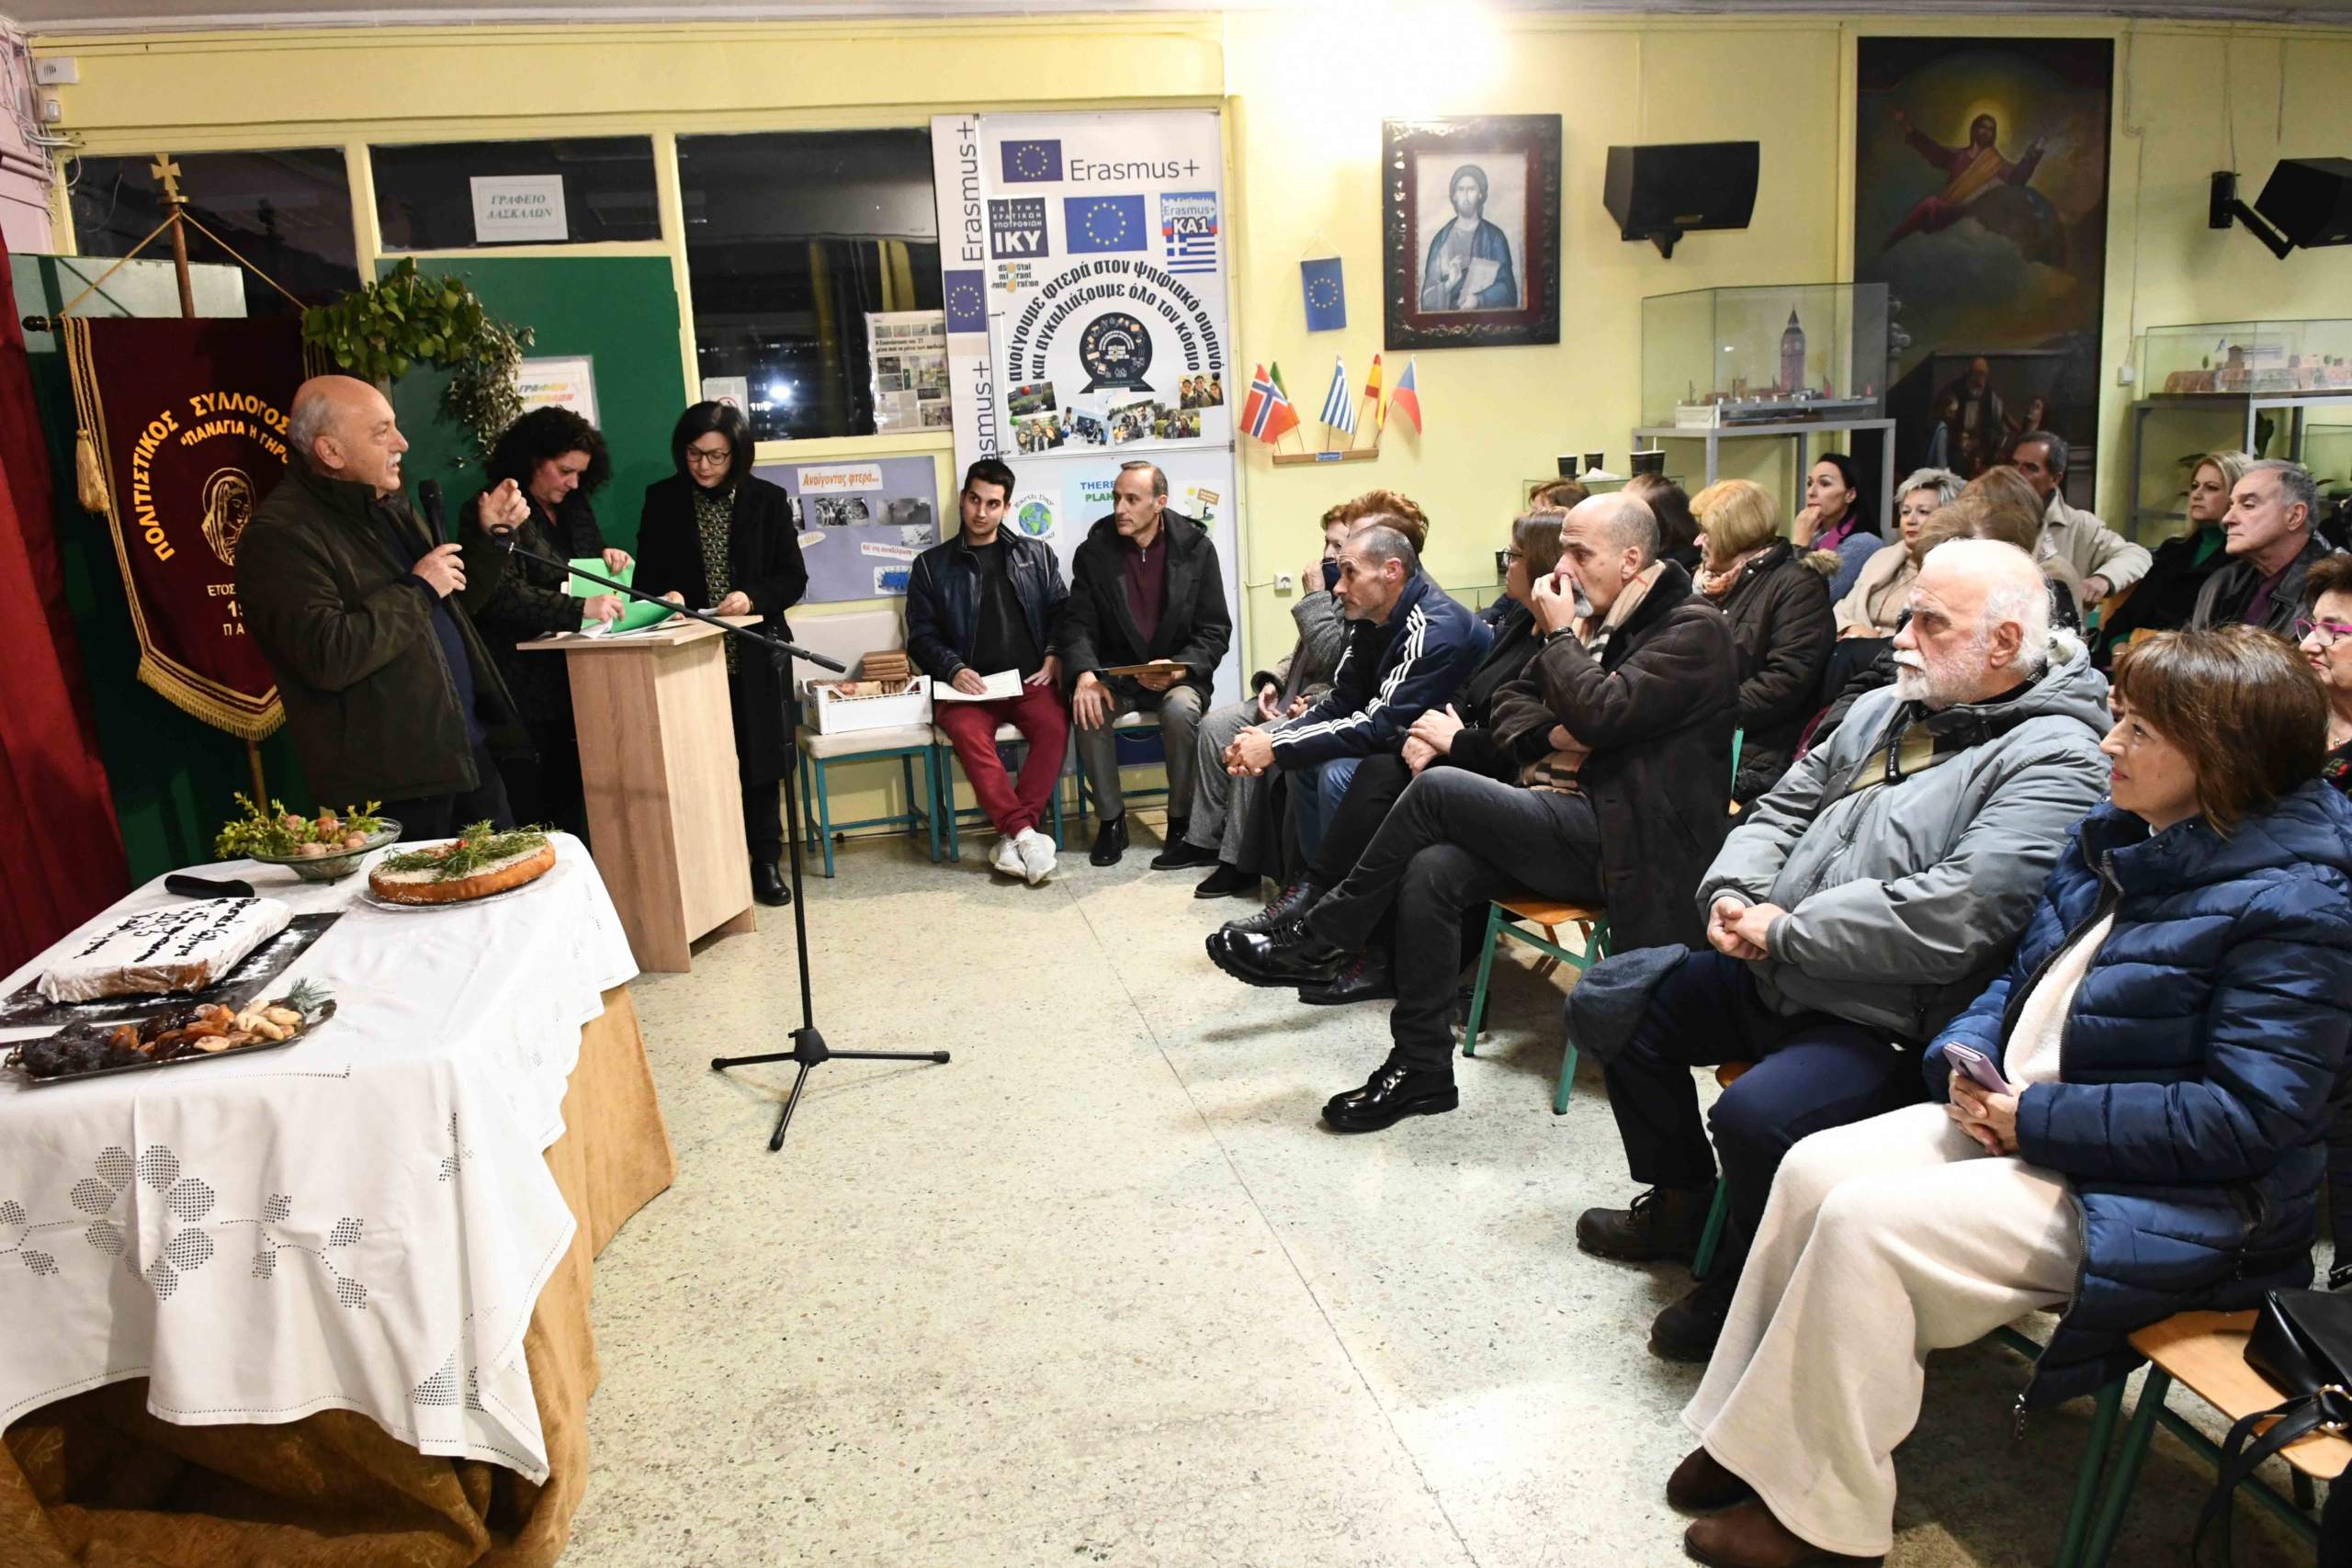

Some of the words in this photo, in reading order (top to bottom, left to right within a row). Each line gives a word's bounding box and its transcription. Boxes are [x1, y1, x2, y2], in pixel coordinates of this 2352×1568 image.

[1069, 158, 1200, 181] Erasmus+
[491, 194, 546, 206] ΓΡΑΦΕΙΟ
[956, 121, 982, 262] Erasmus+
[1171, 216, 1210, 234] KA1
[1128, 282, 1156, 306] όλο
[1008, 296, 1046, 382] ανοίγουμε
[1043, 260, 1091, 299] φτερά
[1093, 259, 1130, 275] στον
[1134, 261, 1202, 313] ψηφιακό
[1194, 310, 1225, 371] ουρανό
[1036, 282, 1125, 348] αγκαλιάζουμε
[1157, 299, 1181, 324] τον
[1174, 320, 1201, 371] κόσμο
[1032, 348, 1046, 380] και
[249, 424, 257, 439] Η
[132, 410, 180, 562] ΠΟΛΙΤΙΣΤΙΚΟΣ
[189, 391, 291, 435] ΣΥΛΛΟΓΟΣ
[1085, 492, 1114, 502] PLAN
[207, 583, 236, 597] ΕΤΟΣ
